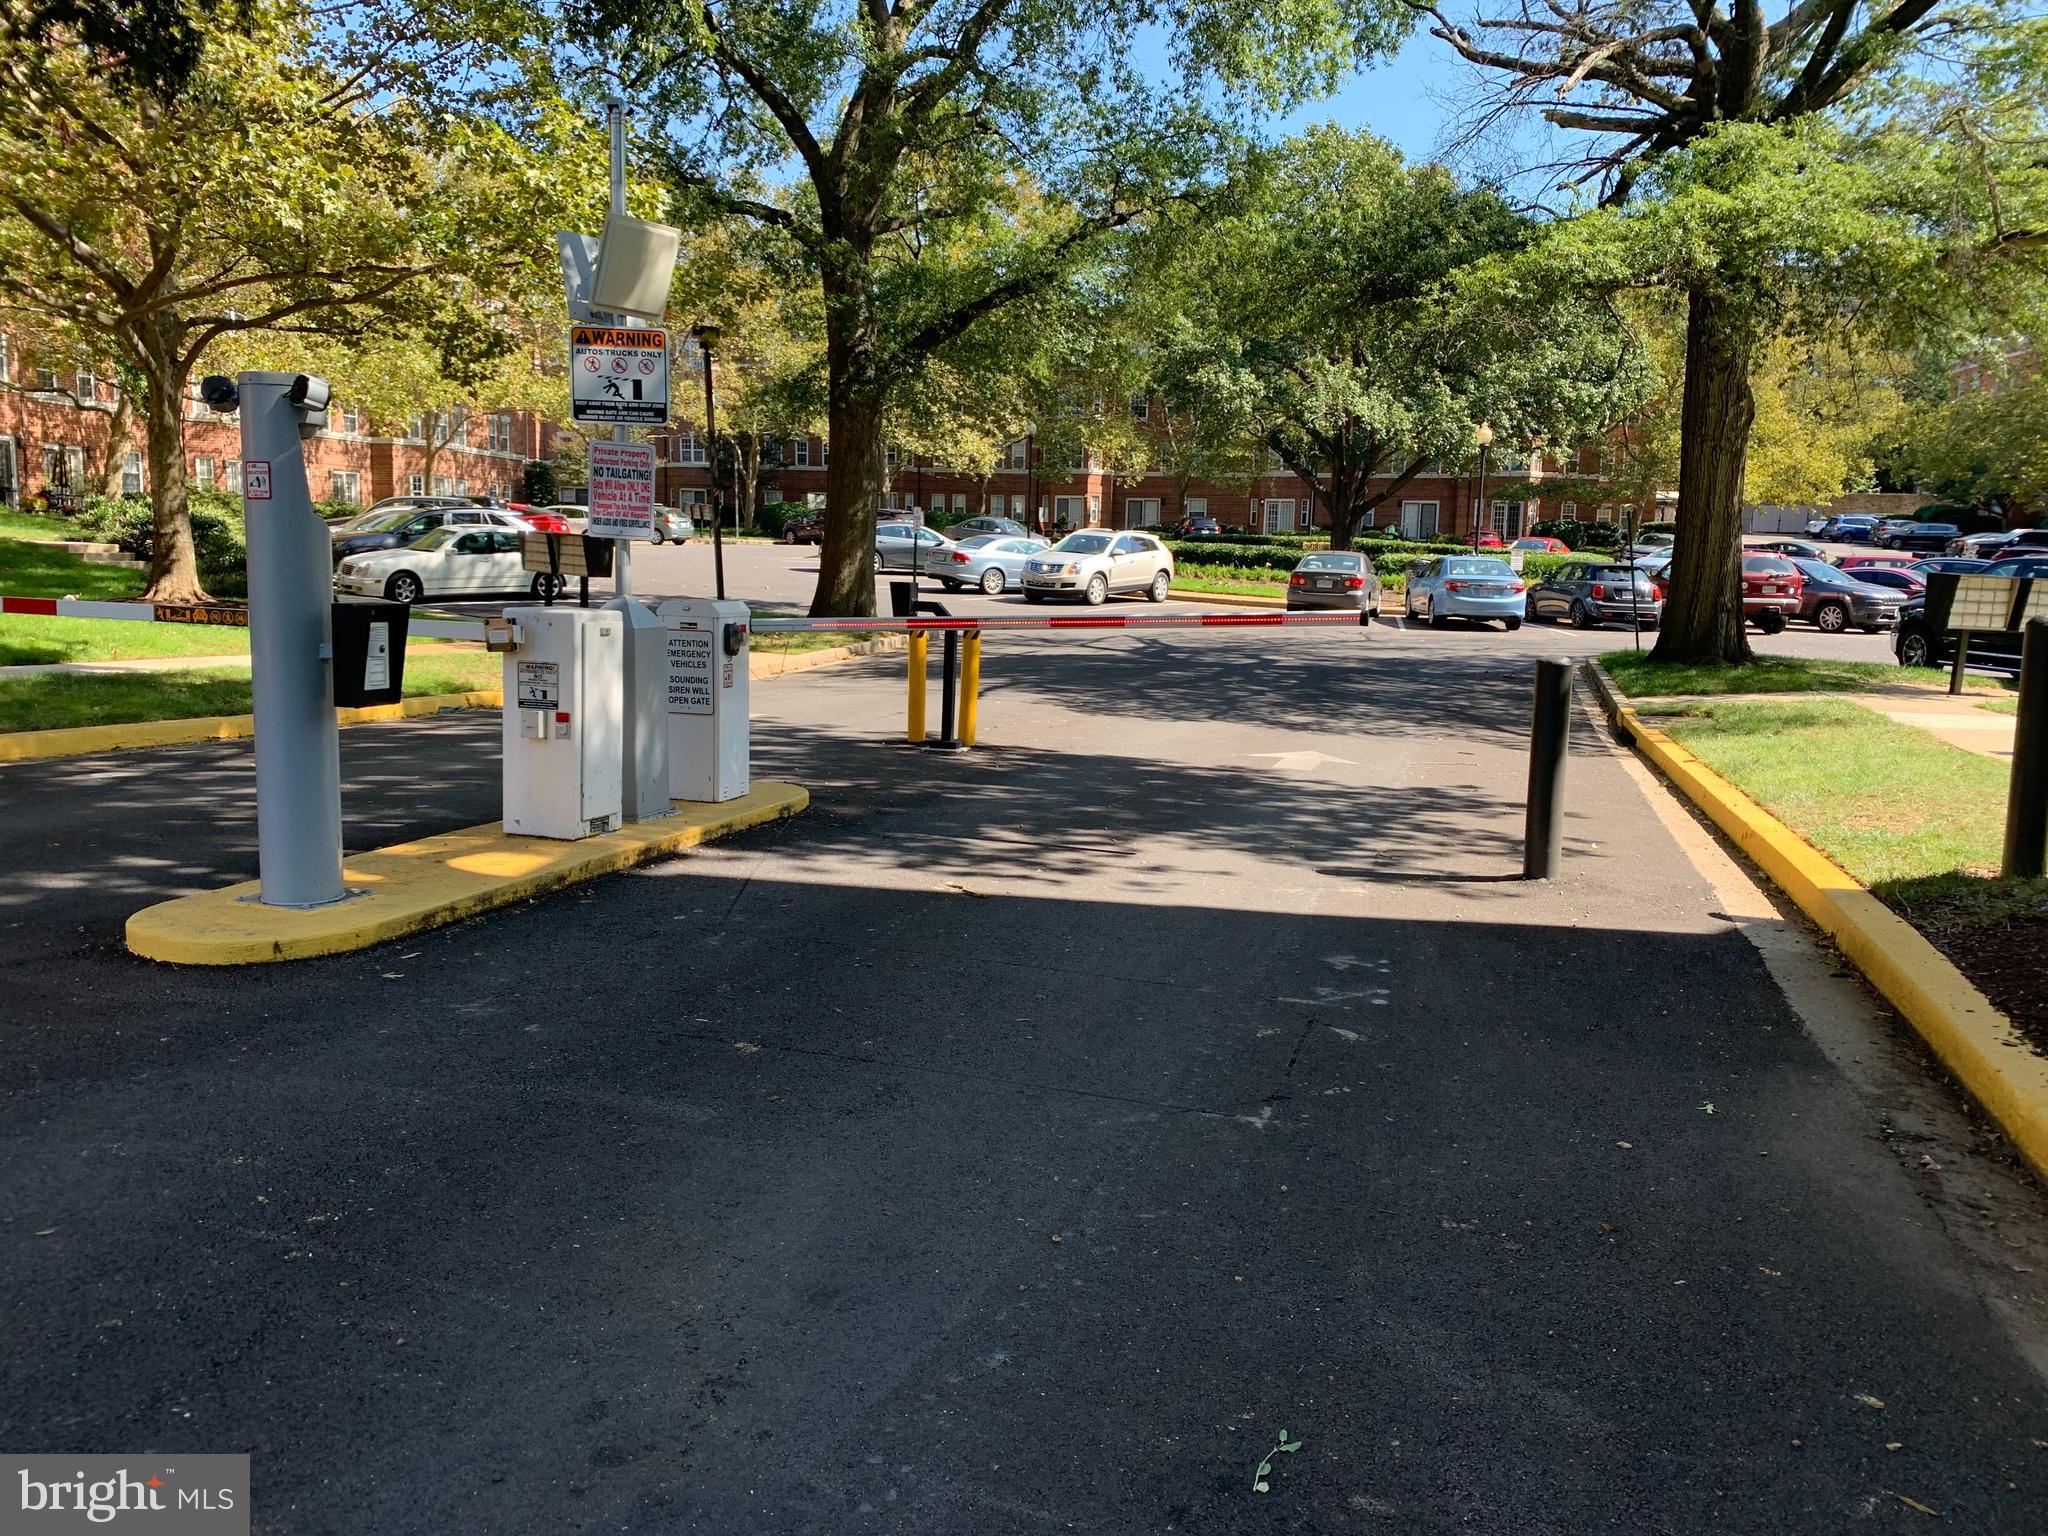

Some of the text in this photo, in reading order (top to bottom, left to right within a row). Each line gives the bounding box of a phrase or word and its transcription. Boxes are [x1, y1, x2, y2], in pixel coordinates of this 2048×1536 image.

[591, 330, 662, 347] WARNING
[641, 350, 662, 358] ONLY
[593, 446, 650, 460] Private Property
[593, 466, 652, 480] NO TAILGATING!
[593, 489, 651, 503] Vehicle At A Time
[668, 639, 709, 648] ATTENTION
[667, 649, 711, 659] EMERGENCY
[670, 660, 707, 669] VEHICLES
[669, 675, 709, 684] SOUNDING
[668, 686, 710, 695] SIREN WILL
[668, 696, 711, 705] OPEN GATE
